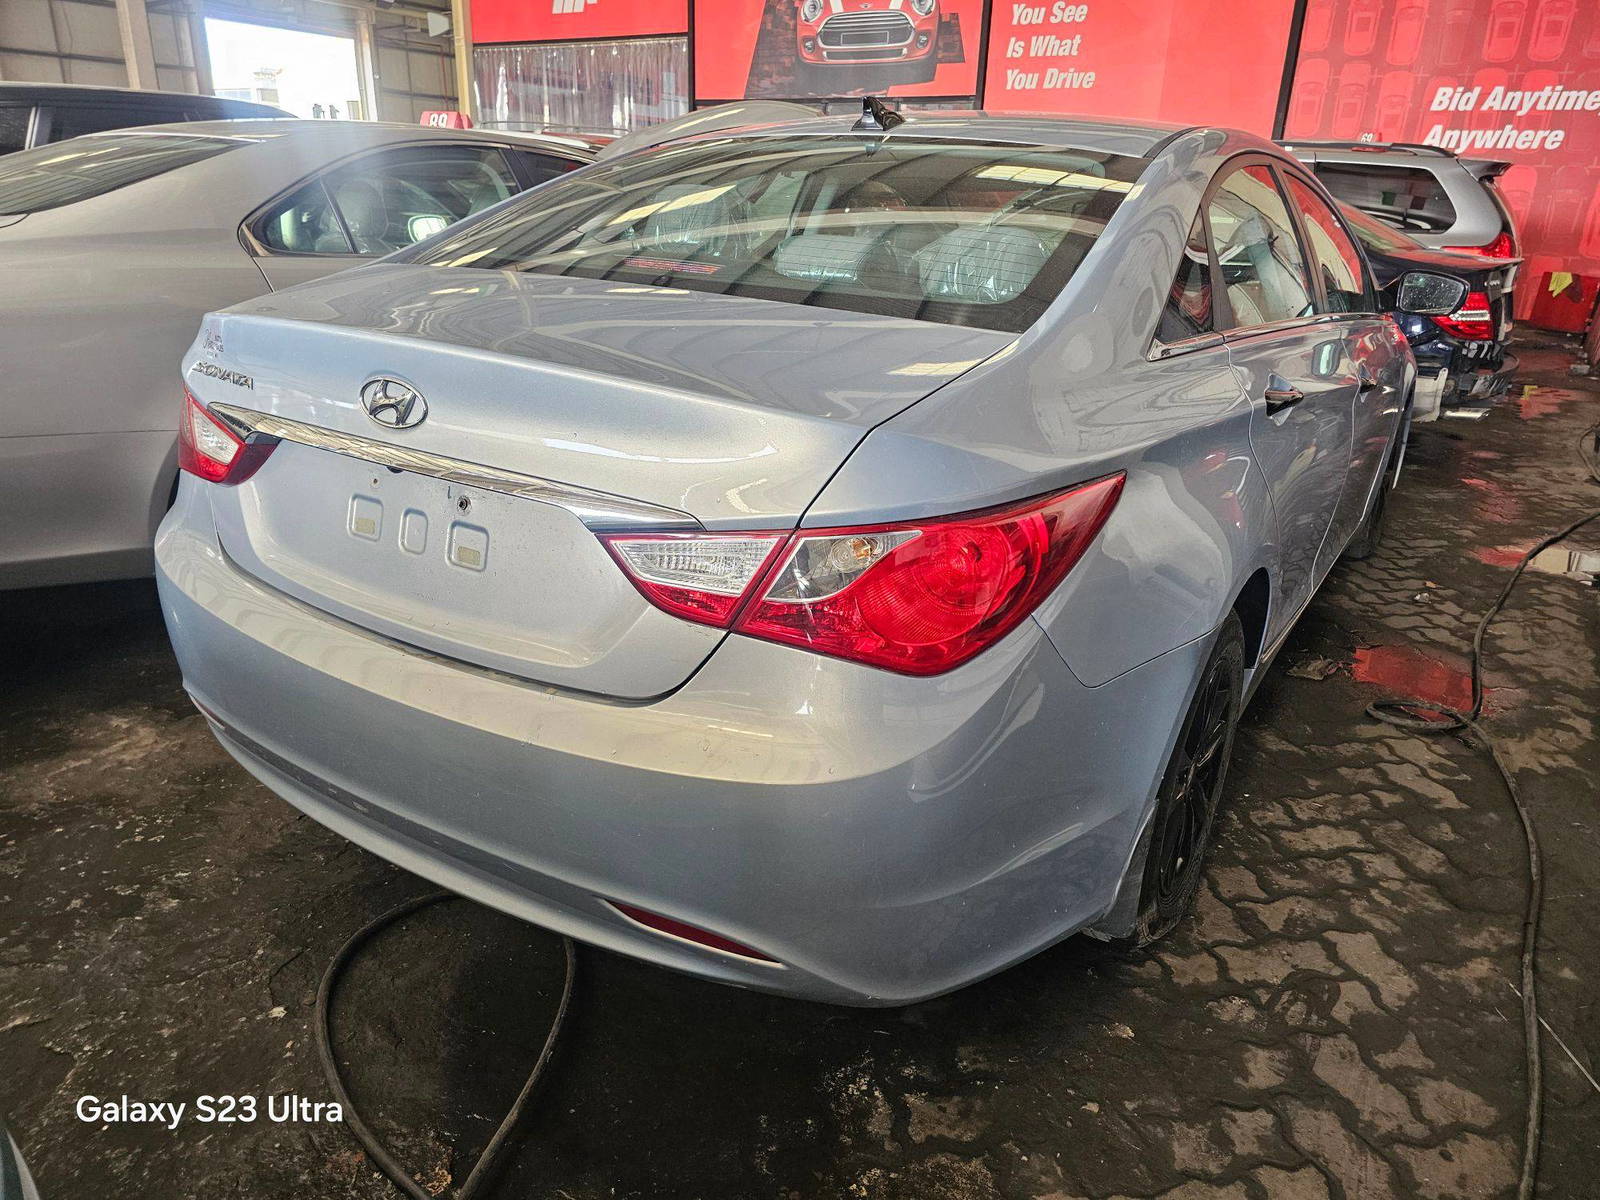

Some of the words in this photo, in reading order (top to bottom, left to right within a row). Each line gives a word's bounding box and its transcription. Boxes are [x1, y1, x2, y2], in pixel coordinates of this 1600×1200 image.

[1011, 3, 1046, 26] You
[1049, 1, 1088, 24] See
[1006, 36, 1025, 58] Is
[1029, 34, 1081, 57] What
[1006, 68, 1039, 90] You
[1042, 67, 1096, 89] Drive
[1429, 86, 1482, 111] Bid
[1421, 124, 1565, 153] Anywhere
[191, 360, 254, 391] SONATA
